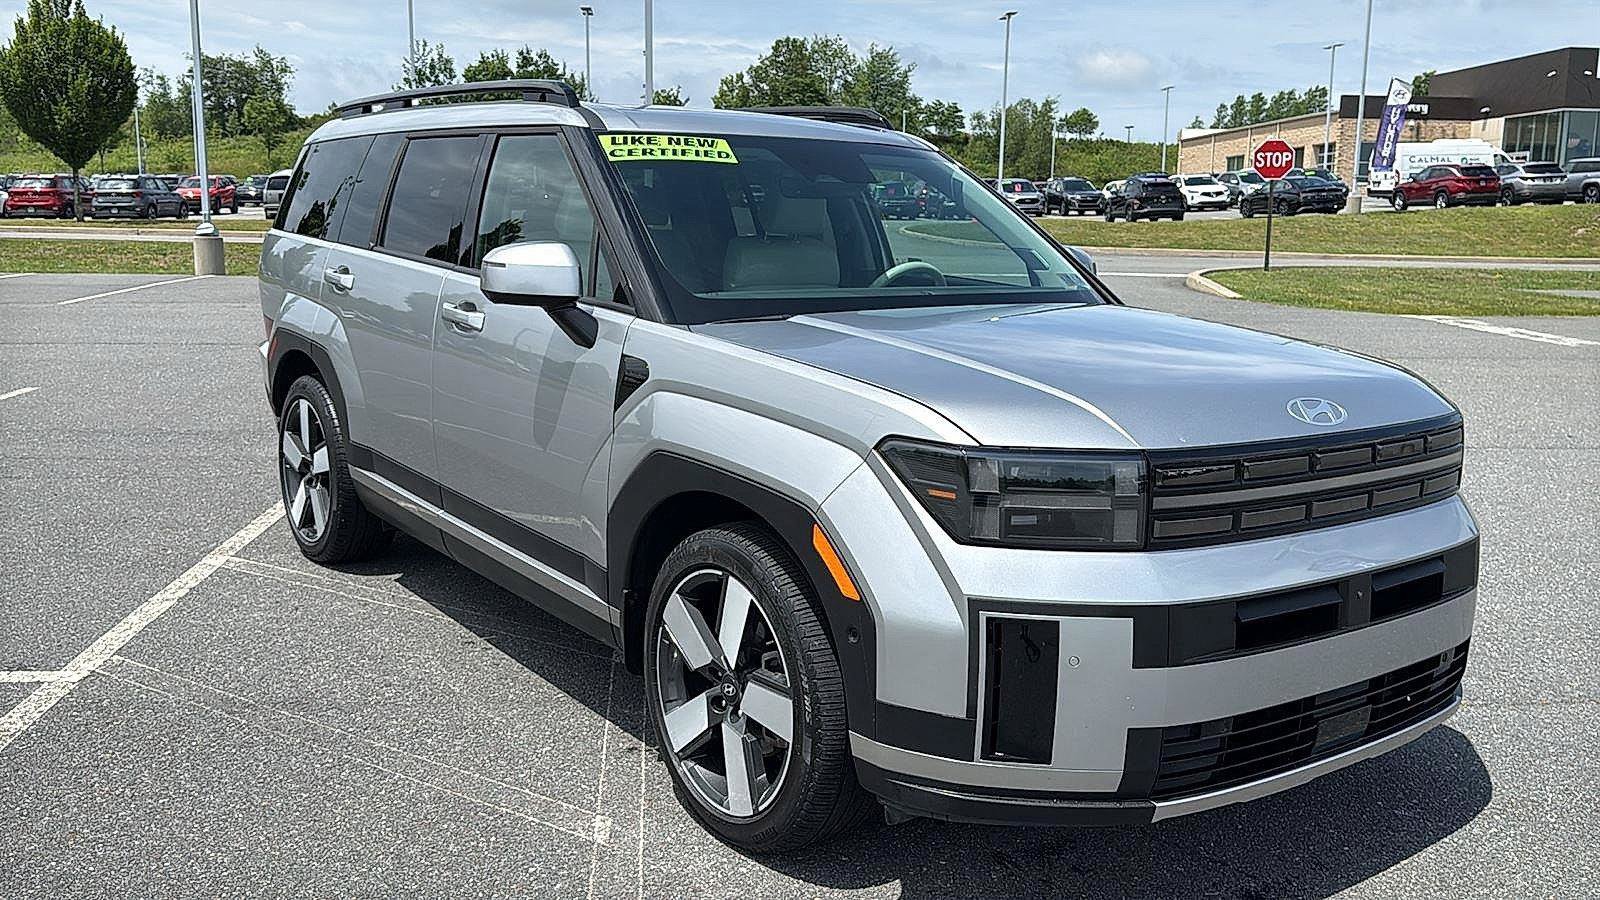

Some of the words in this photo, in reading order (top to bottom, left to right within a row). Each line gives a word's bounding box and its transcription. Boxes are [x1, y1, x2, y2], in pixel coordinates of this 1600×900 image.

[610, 136, 658, 146] LIKE
[667, 138, 716, 149] NEW
[608, 148, 731, 159] CERTIFIED
[1255, 152, 1292, 168] STOP
